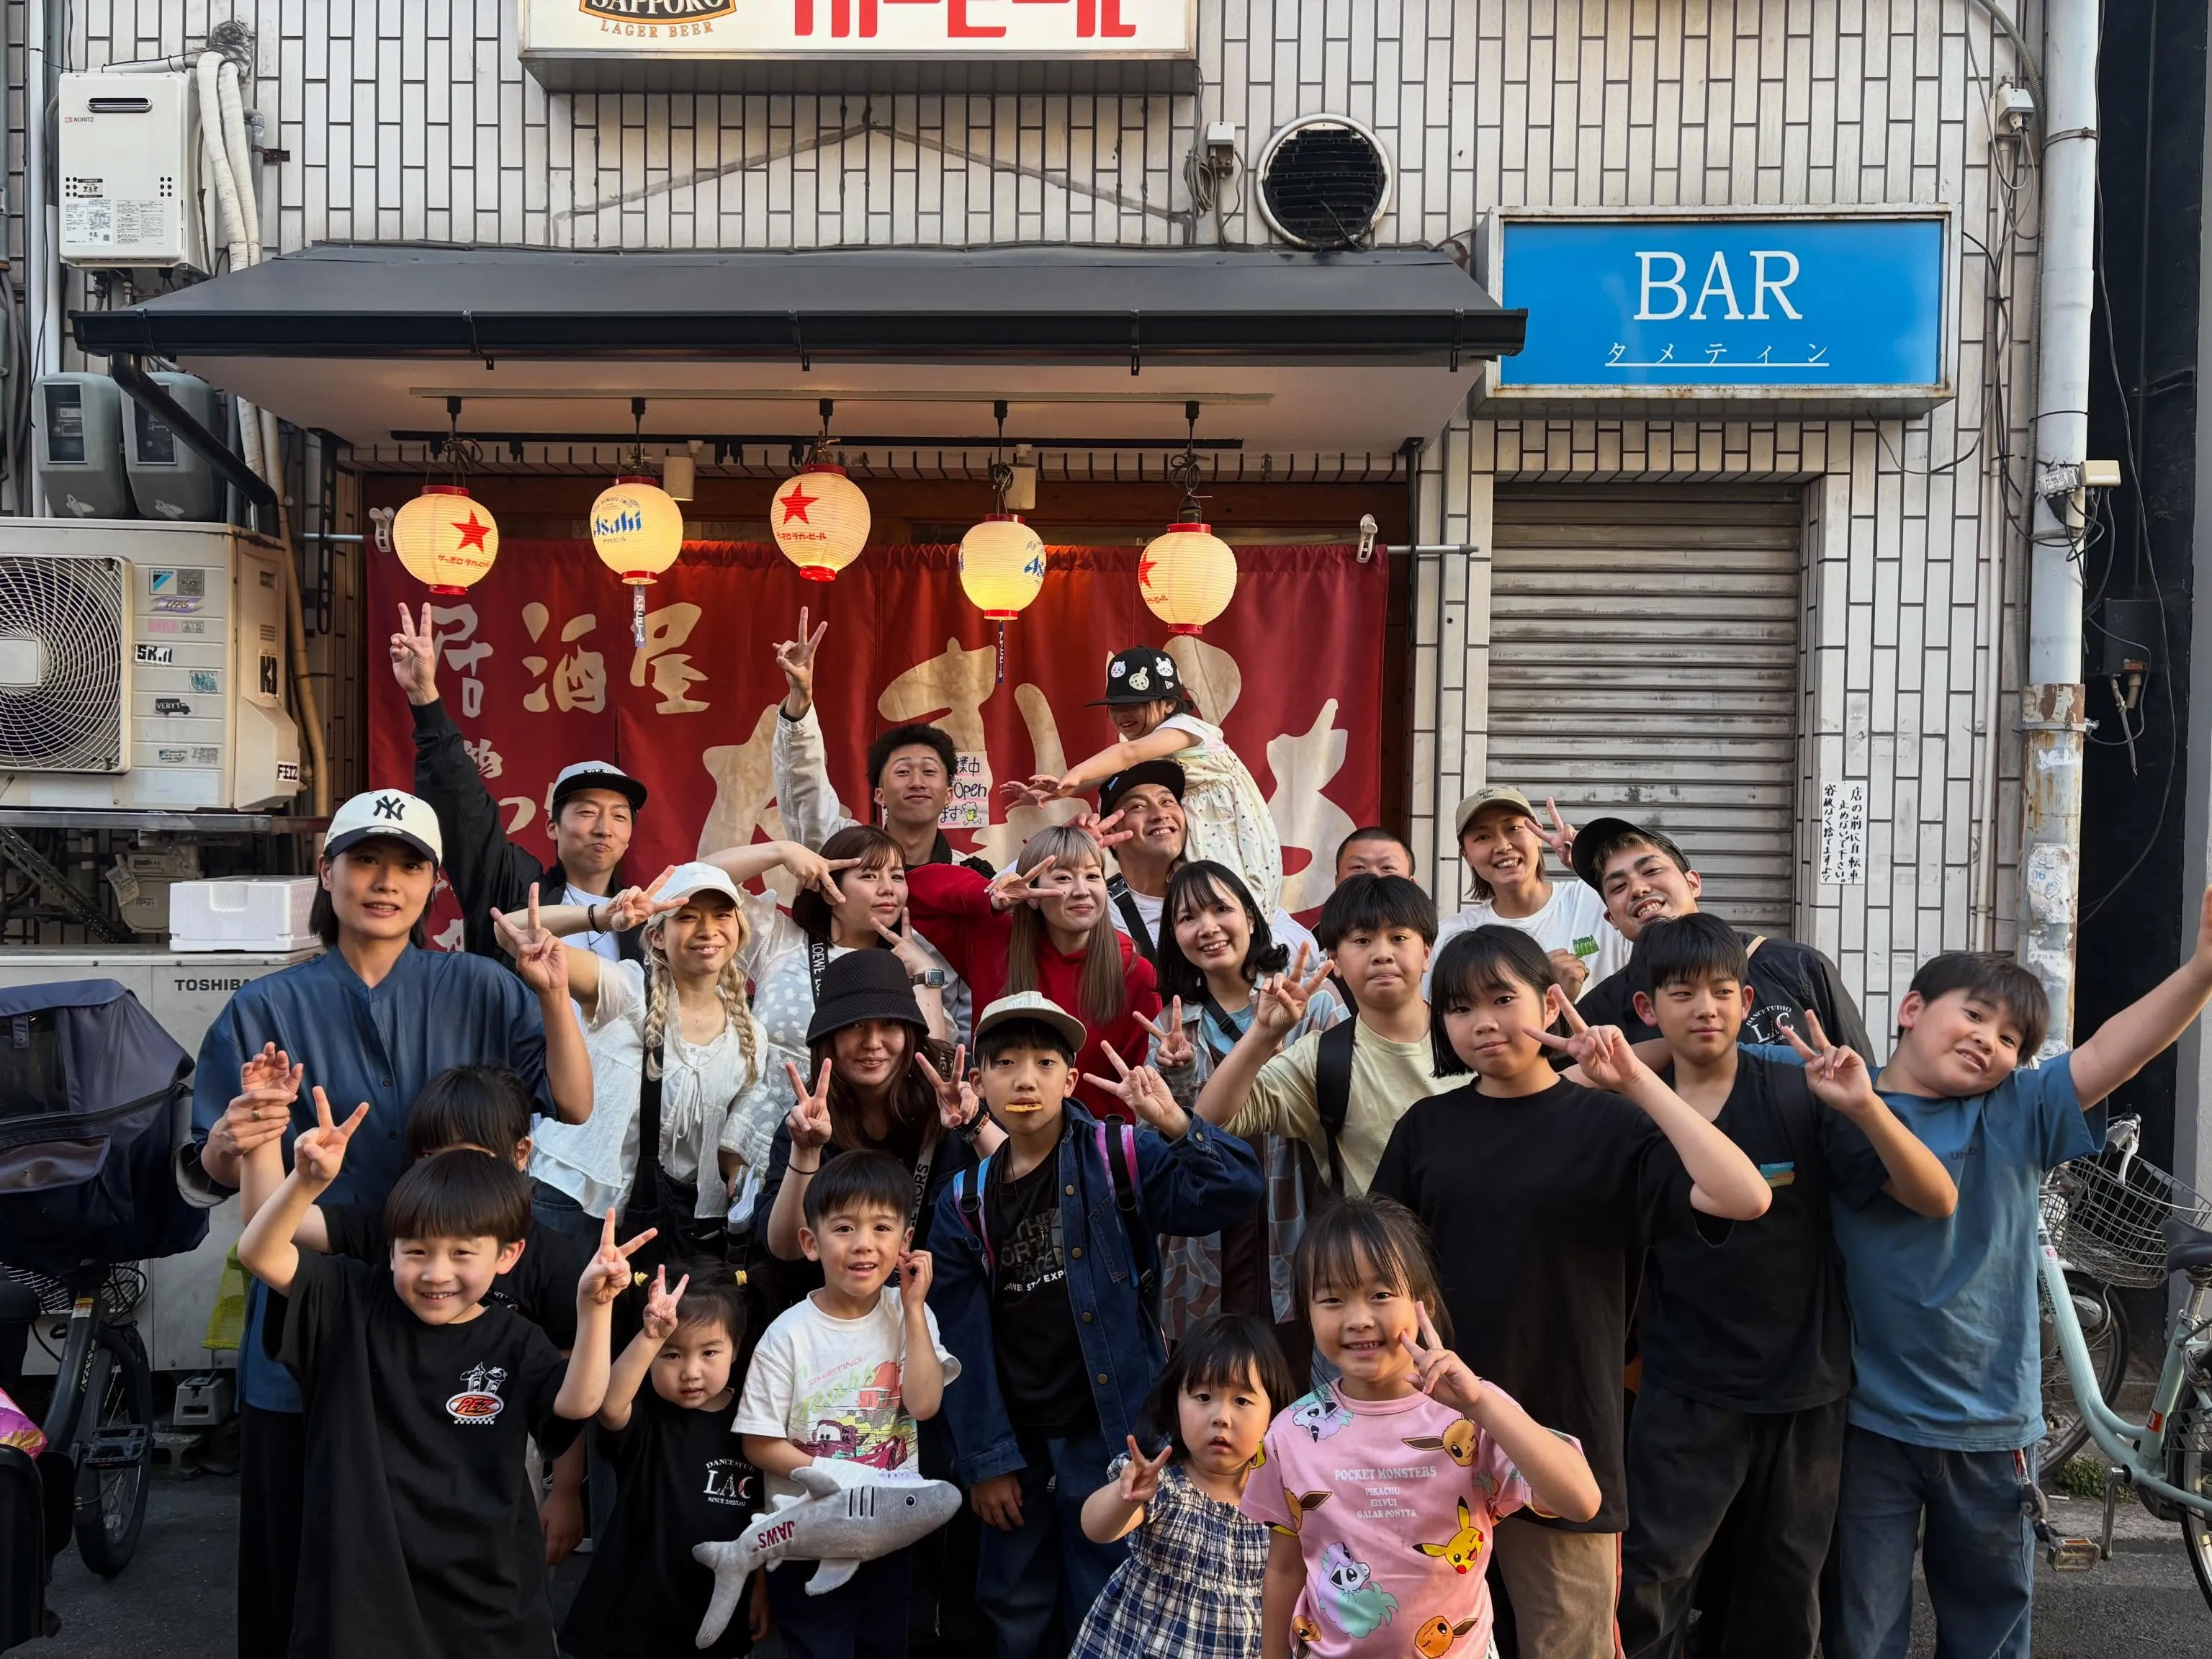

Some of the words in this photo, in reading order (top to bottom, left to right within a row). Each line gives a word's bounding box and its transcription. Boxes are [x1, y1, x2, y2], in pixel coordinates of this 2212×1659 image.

[600, 19, 658, 37] LAGER
[669, 22, 714, 37] BEER
[1633, 250, 1802, 320] BAR
[635, 595, 645, 642] アサヒビール
[956, 755, 980, 776] 業中
[954, 782, 987, 800] Open
[373, 795, 406, 821] NY
[1848, 786, 1863, 884] 店の前に自転車
[811, 942, 826, 975] LOEWE
[174, 979, 250, 991] TOSHIB
[454, 1397, 495, 1413] PEZ
[706, 1458, 734, 1470] DANCE
[1335, 1469, 1375, 1480] POCKET
[1377, 1466, 1437, 1480] MONSTERS
[1365, 1487, 1400, 1496] PIKACHU
[1357, 1510, 1383, 1519] GALAR
[757, 1520, 795, 1549] JAWS
